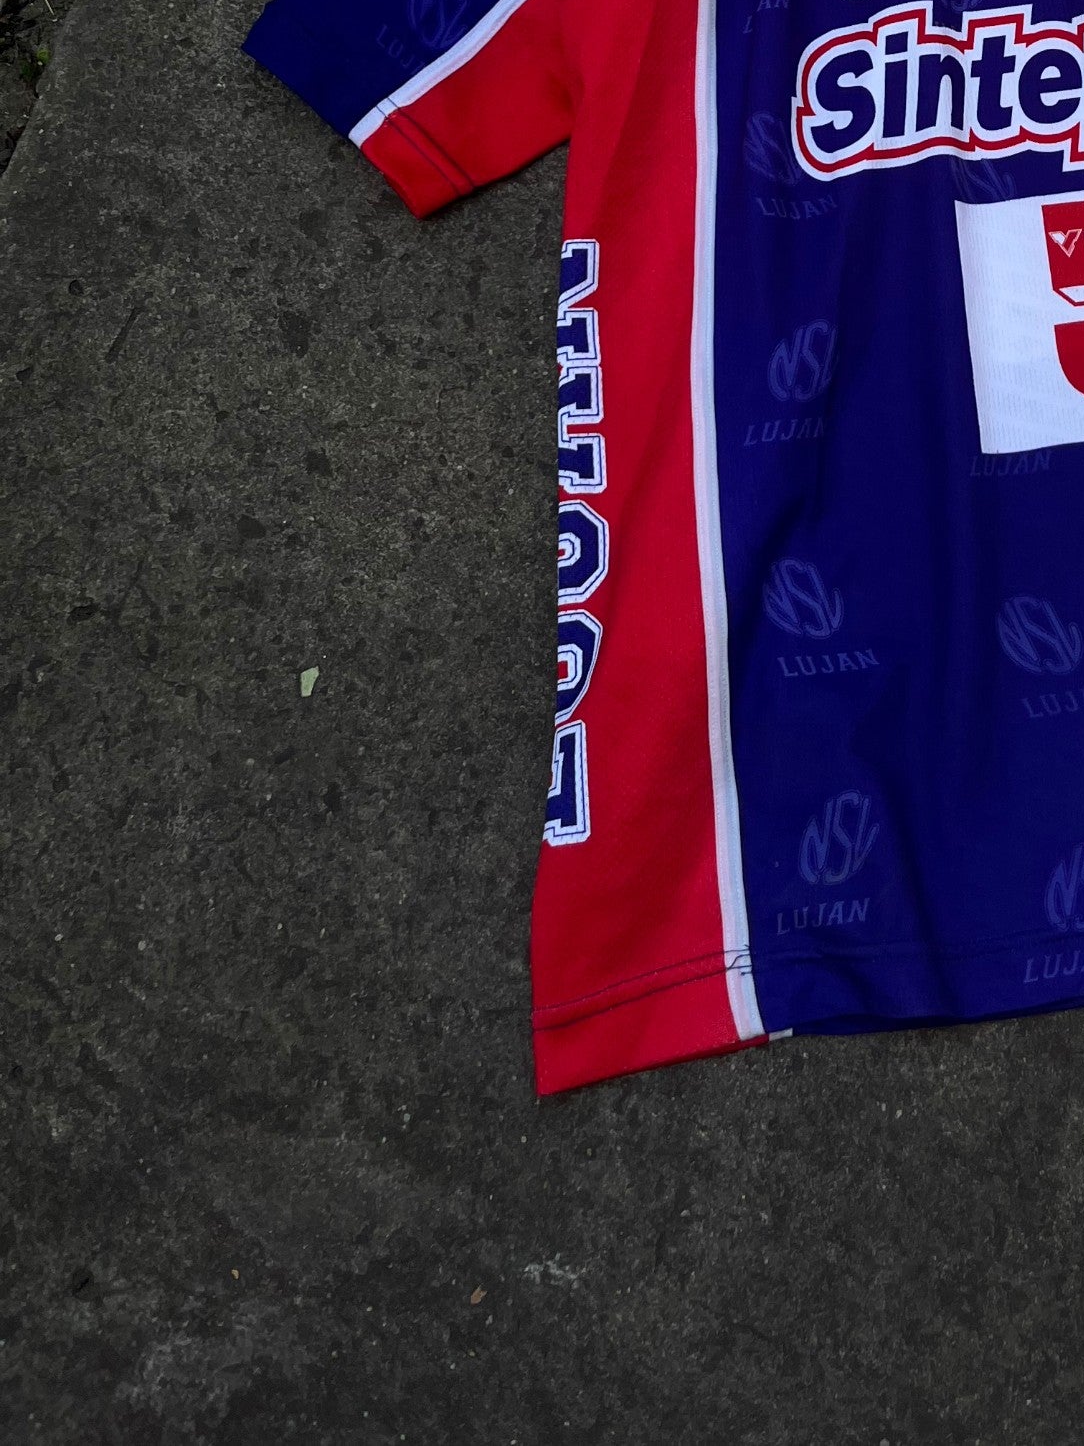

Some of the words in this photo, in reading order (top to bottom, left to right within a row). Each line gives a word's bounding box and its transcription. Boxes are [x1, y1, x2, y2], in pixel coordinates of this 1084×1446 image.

[744, 413, 833, 448] LUJAN
[776, 648, 880, 678] LUJAN
[775, 897, 871, 936] LUJAN
